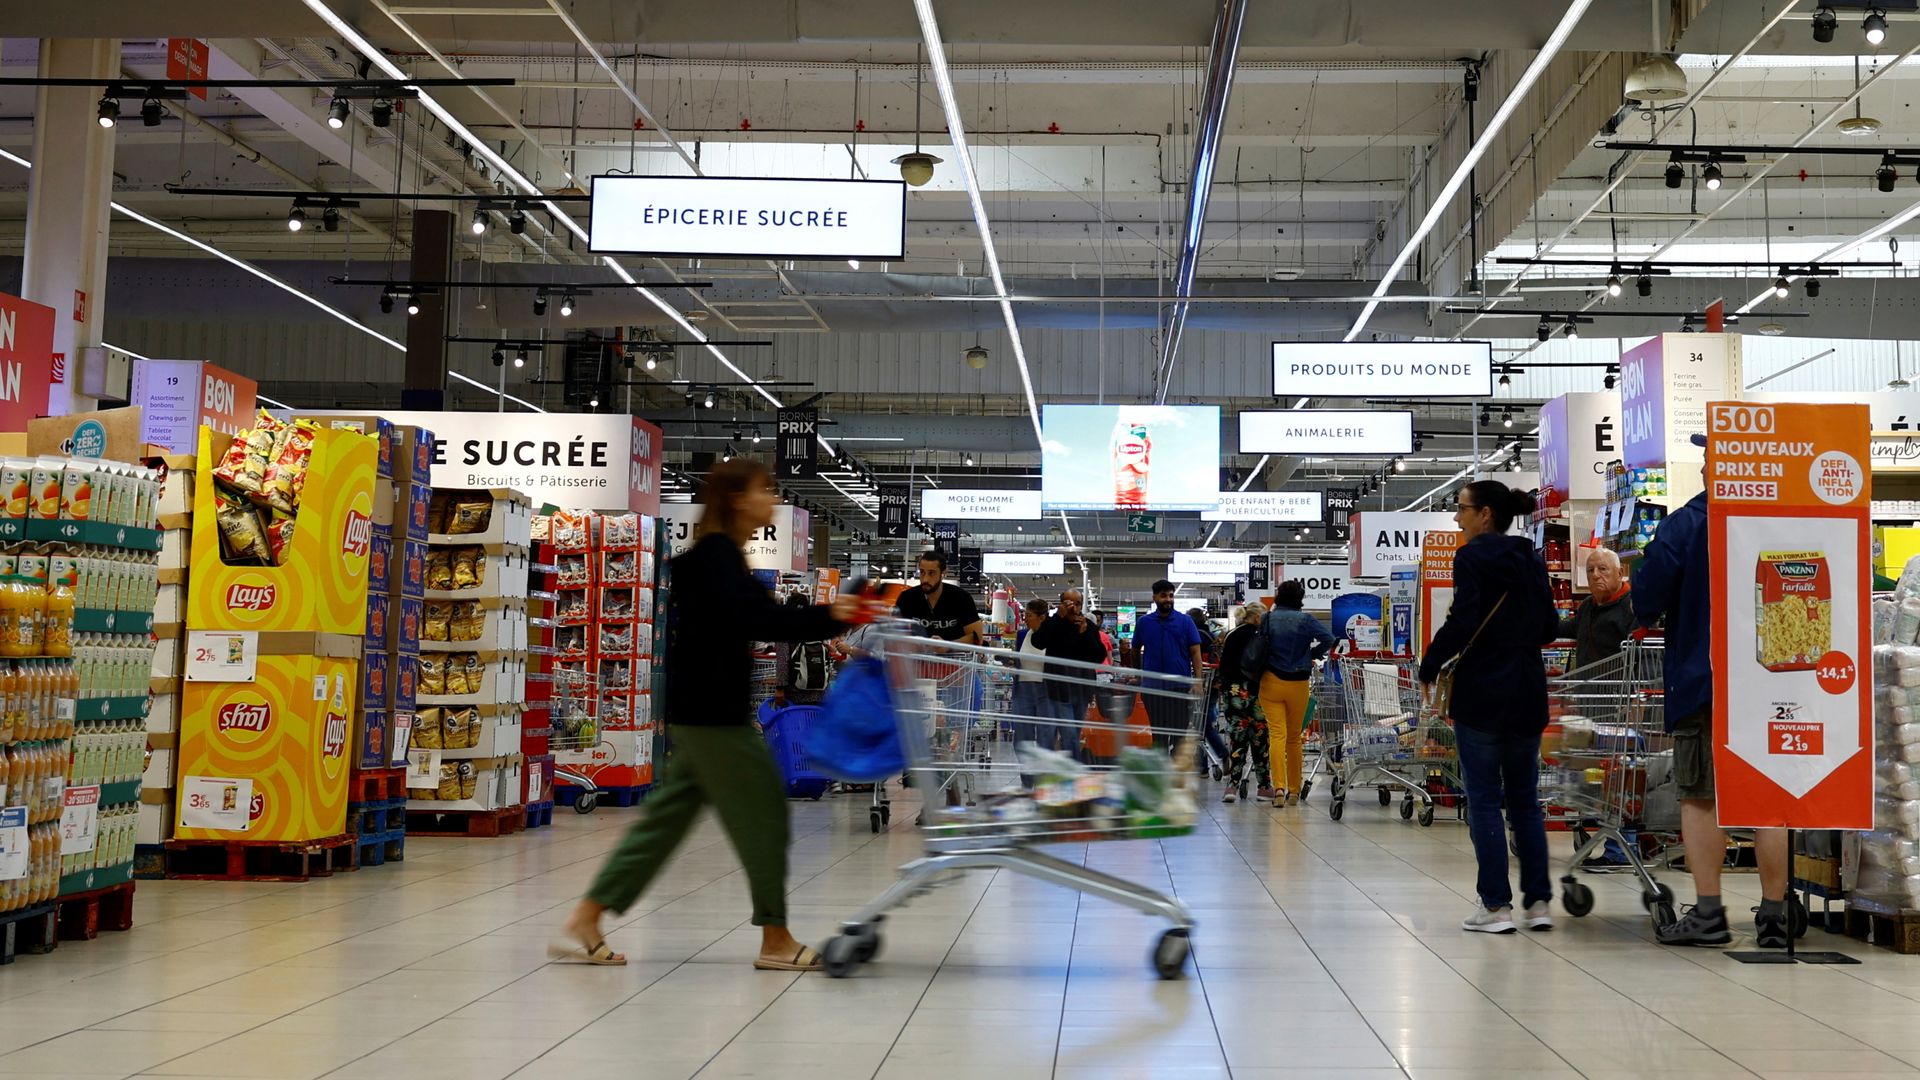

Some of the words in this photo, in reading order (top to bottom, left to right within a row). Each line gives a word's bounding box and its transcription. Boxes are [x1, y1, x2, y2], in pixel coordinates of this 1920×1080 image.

[643, 204, 749, 225] ÉPICERIE
[758, 207, 848, 228] SUCRÉE
[1689, 352, 1703, 363] 34
[1291, 363, 1375, 376] PRODUITS
[1381, 364, 1404, 376] DU
[1411, 364, 1472, 376] MONDE
[166, 377, 179, 386] 19
[1623, 357, 1645, 402] BON
[204, 374, 235, 417] BON
[779, 411, 815, 422] BORNE
[1715, 407, 1773, 433] 500
[779, 422, 815, 434] PRIX
[1624, 401, 1653, 446] PLAN
[1285, 427, 1365, 438] ANIMALERIE
[631, 426, 651, 460] BON
[1715, 440, 1815, 457] NOUVEAUX
[463, 435, 608, 468] SUCRÉE
[1715, 461, 1756, 477] PRIX
[1760, 462, 1784, 478] EN
[1820, 459, 1847, 469] DEFI
[632, 460, 653, 495] PLAN
[1822, 469, 1854, 478] ANTI-
[467, 473, 521, 487] Biscuits
[525, 475, 535, 487] &
[540, 473, 608, 488] Pâtisserie
[1818, 477, 1853, 487] INFLA
[1715, 483, 1775, 498] BAISSE
[1824, 487, 1854, 497] TION
[880, 495, 908, 505] PRIX
[948, 495, 976, 503] MODE
[978, 495, 1014, 503] HOMME
[1218, 497, 1237, 505] ODE
[1240, 497, 1277, 505] ENFANT
[1279, 497, 1285, 505] &
[1327, 498, 1353, 508] PRIX
[1225, 507, 1296, 515] PUÉRICULTURE
[935, 531, 957, 539] PRIX
[1375, 530, 1427, 548] ANI
[1426, 533, 1456, 546] 500
[759, 546, 778, 555] Thé
[1375, 552, 1405, 562] Chats,
[1426, 560, 1447, 568] PRIX
[1779, 565, 1815, 574] PANZANI
[1782, 582, 1816, 592] Farfalle
[228, 585, 273, 611] Lay's
[1806, 724, 1820, 732] PRIX
